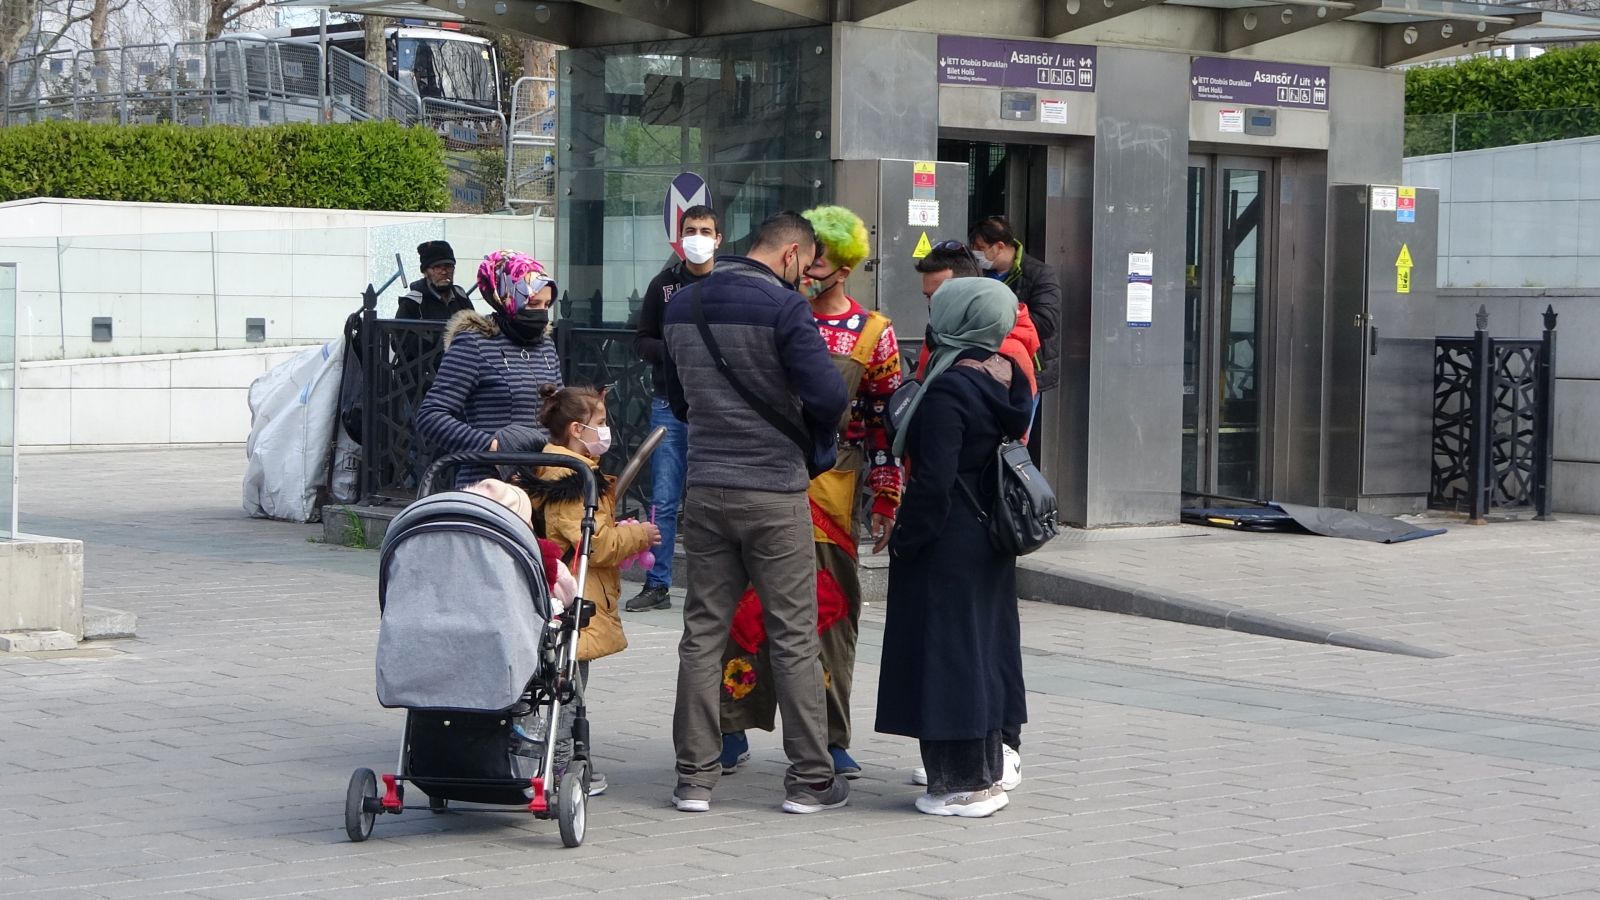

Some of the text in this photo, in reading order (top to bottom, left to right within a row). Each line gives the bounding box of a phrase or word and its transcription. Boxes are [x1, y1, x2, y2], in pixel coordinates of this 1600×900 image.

[960, 58, 981, 66] Otobüs
[1010, 51, 1075, 67] Asansör / Lift
[946, 67, 975, 76] Bilet Holü
[1210, 77, 1228, 86] Otobüs
[1253, 71, 1311, 86] Asansör / Lift
[670, 182, 706, 243] M
